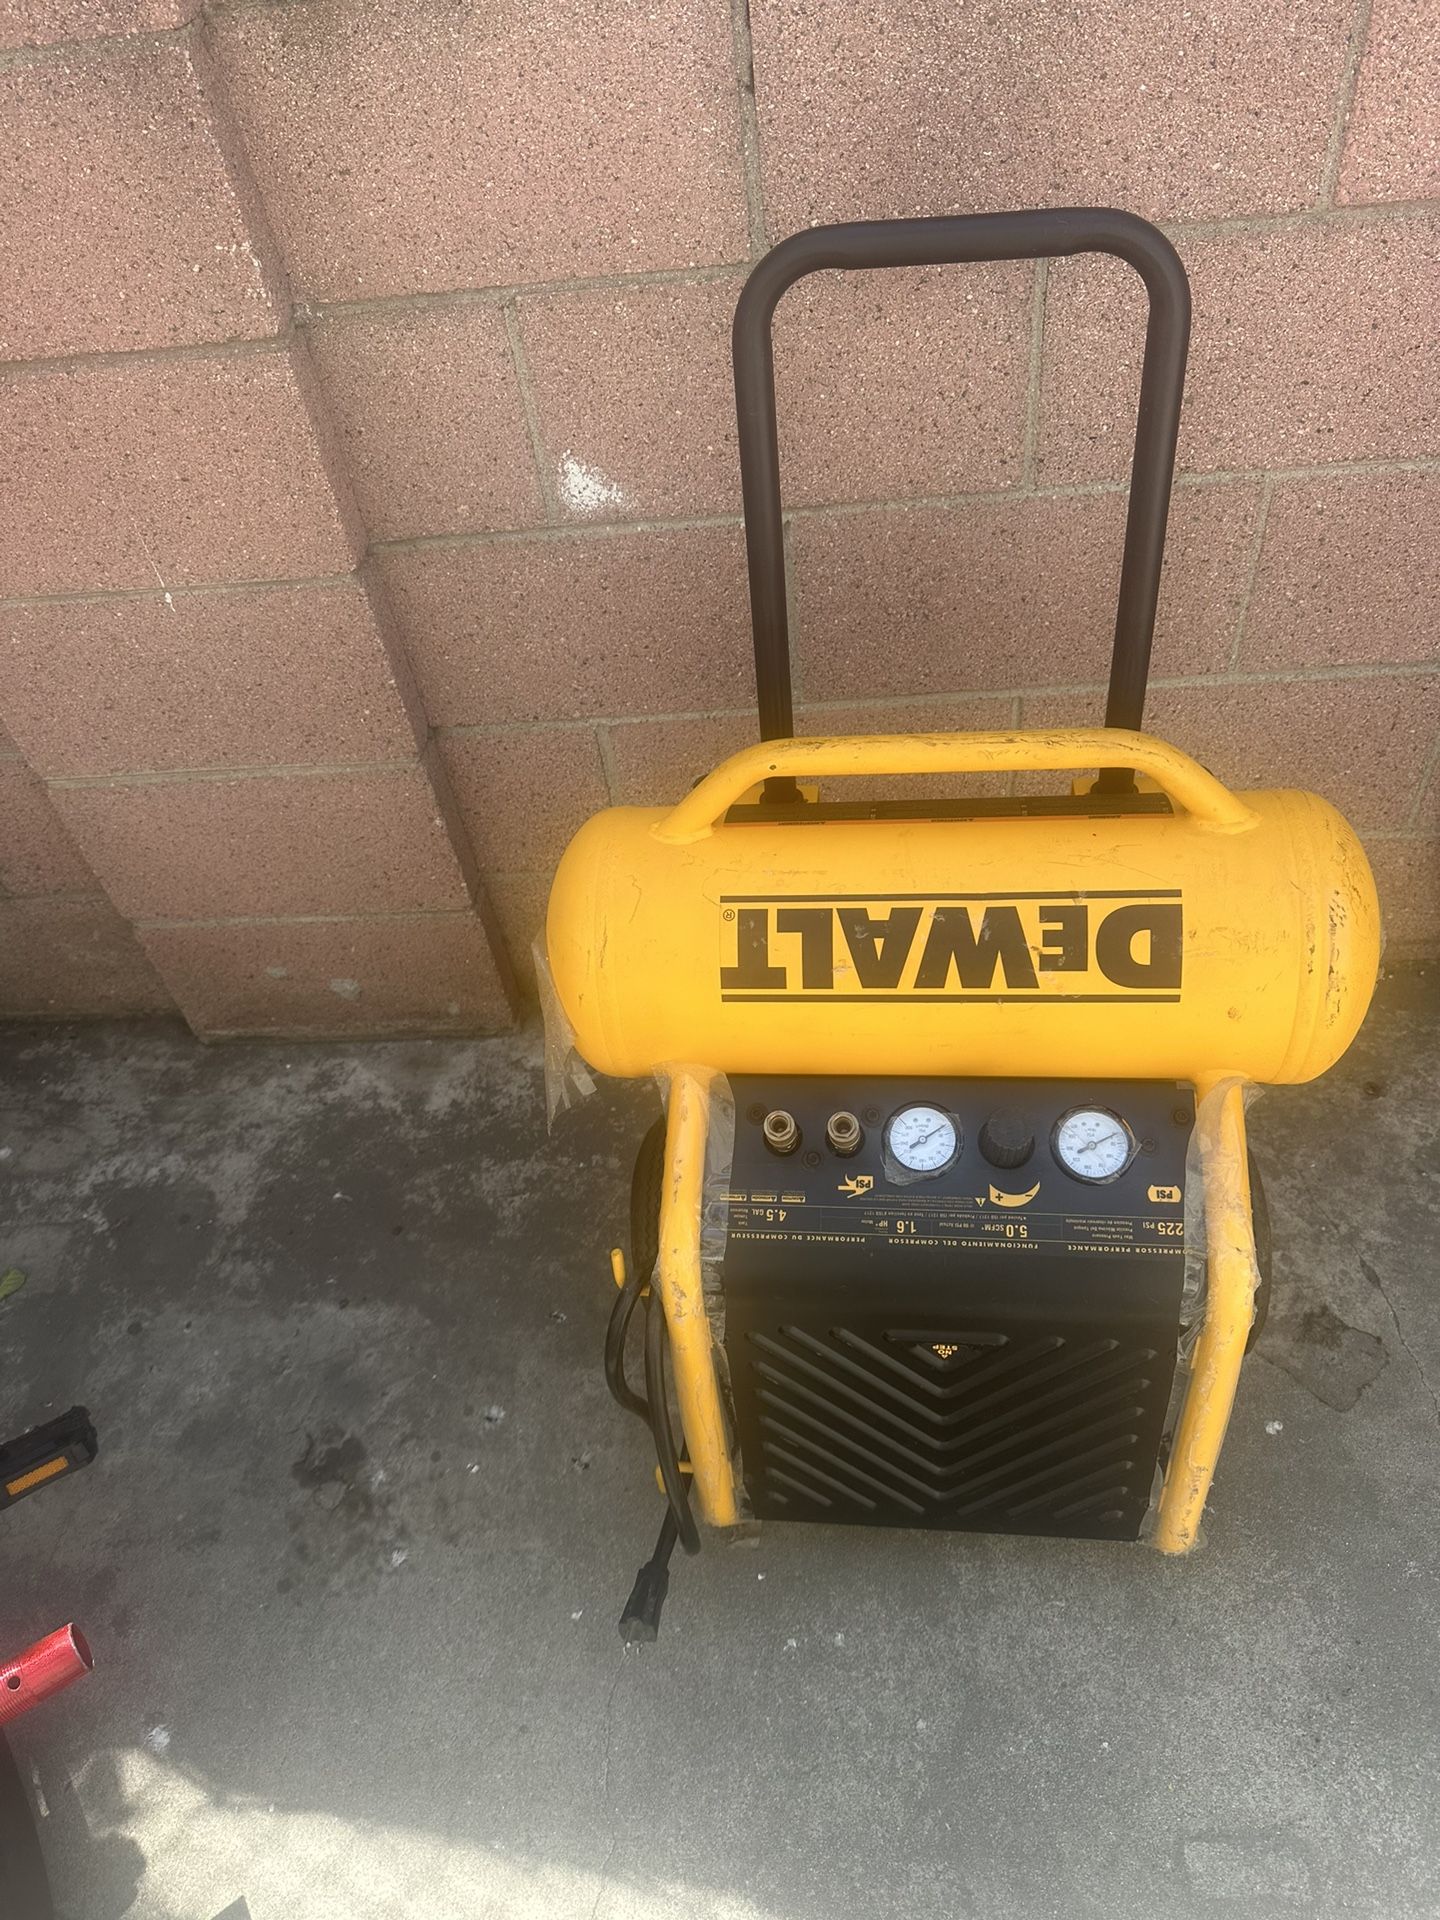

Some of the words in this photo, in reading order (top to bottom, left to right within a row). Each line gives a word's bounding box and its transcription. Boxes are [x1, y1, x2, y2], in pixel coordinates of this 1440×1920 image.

[856, 1179, 871, 1189] PSI
[1156, 1190, 1173, 1200] PSI
[751, 1208, 764, 1216] GAL
[766, 1208, 787, 1222] 4.5
[896, 1220, 917, 1234] 1.6
[1142, 1221, 1155, 1230] PSI
[1157, 1222, 1184, 1236] 225
[1005, 1224, 1028, 1238] 5.0
[730, 1232, 788, 1240] COMPRESSEUR
[806, 1235, 866, 1243] PERFORMANCE
[888, 1238, 938, 1246] COMPRESOR
[961, 1240, 1038, 1249] FUNCIONAMIENTO
[1067, 1245, 1130, 1253] PERFORMANCE
